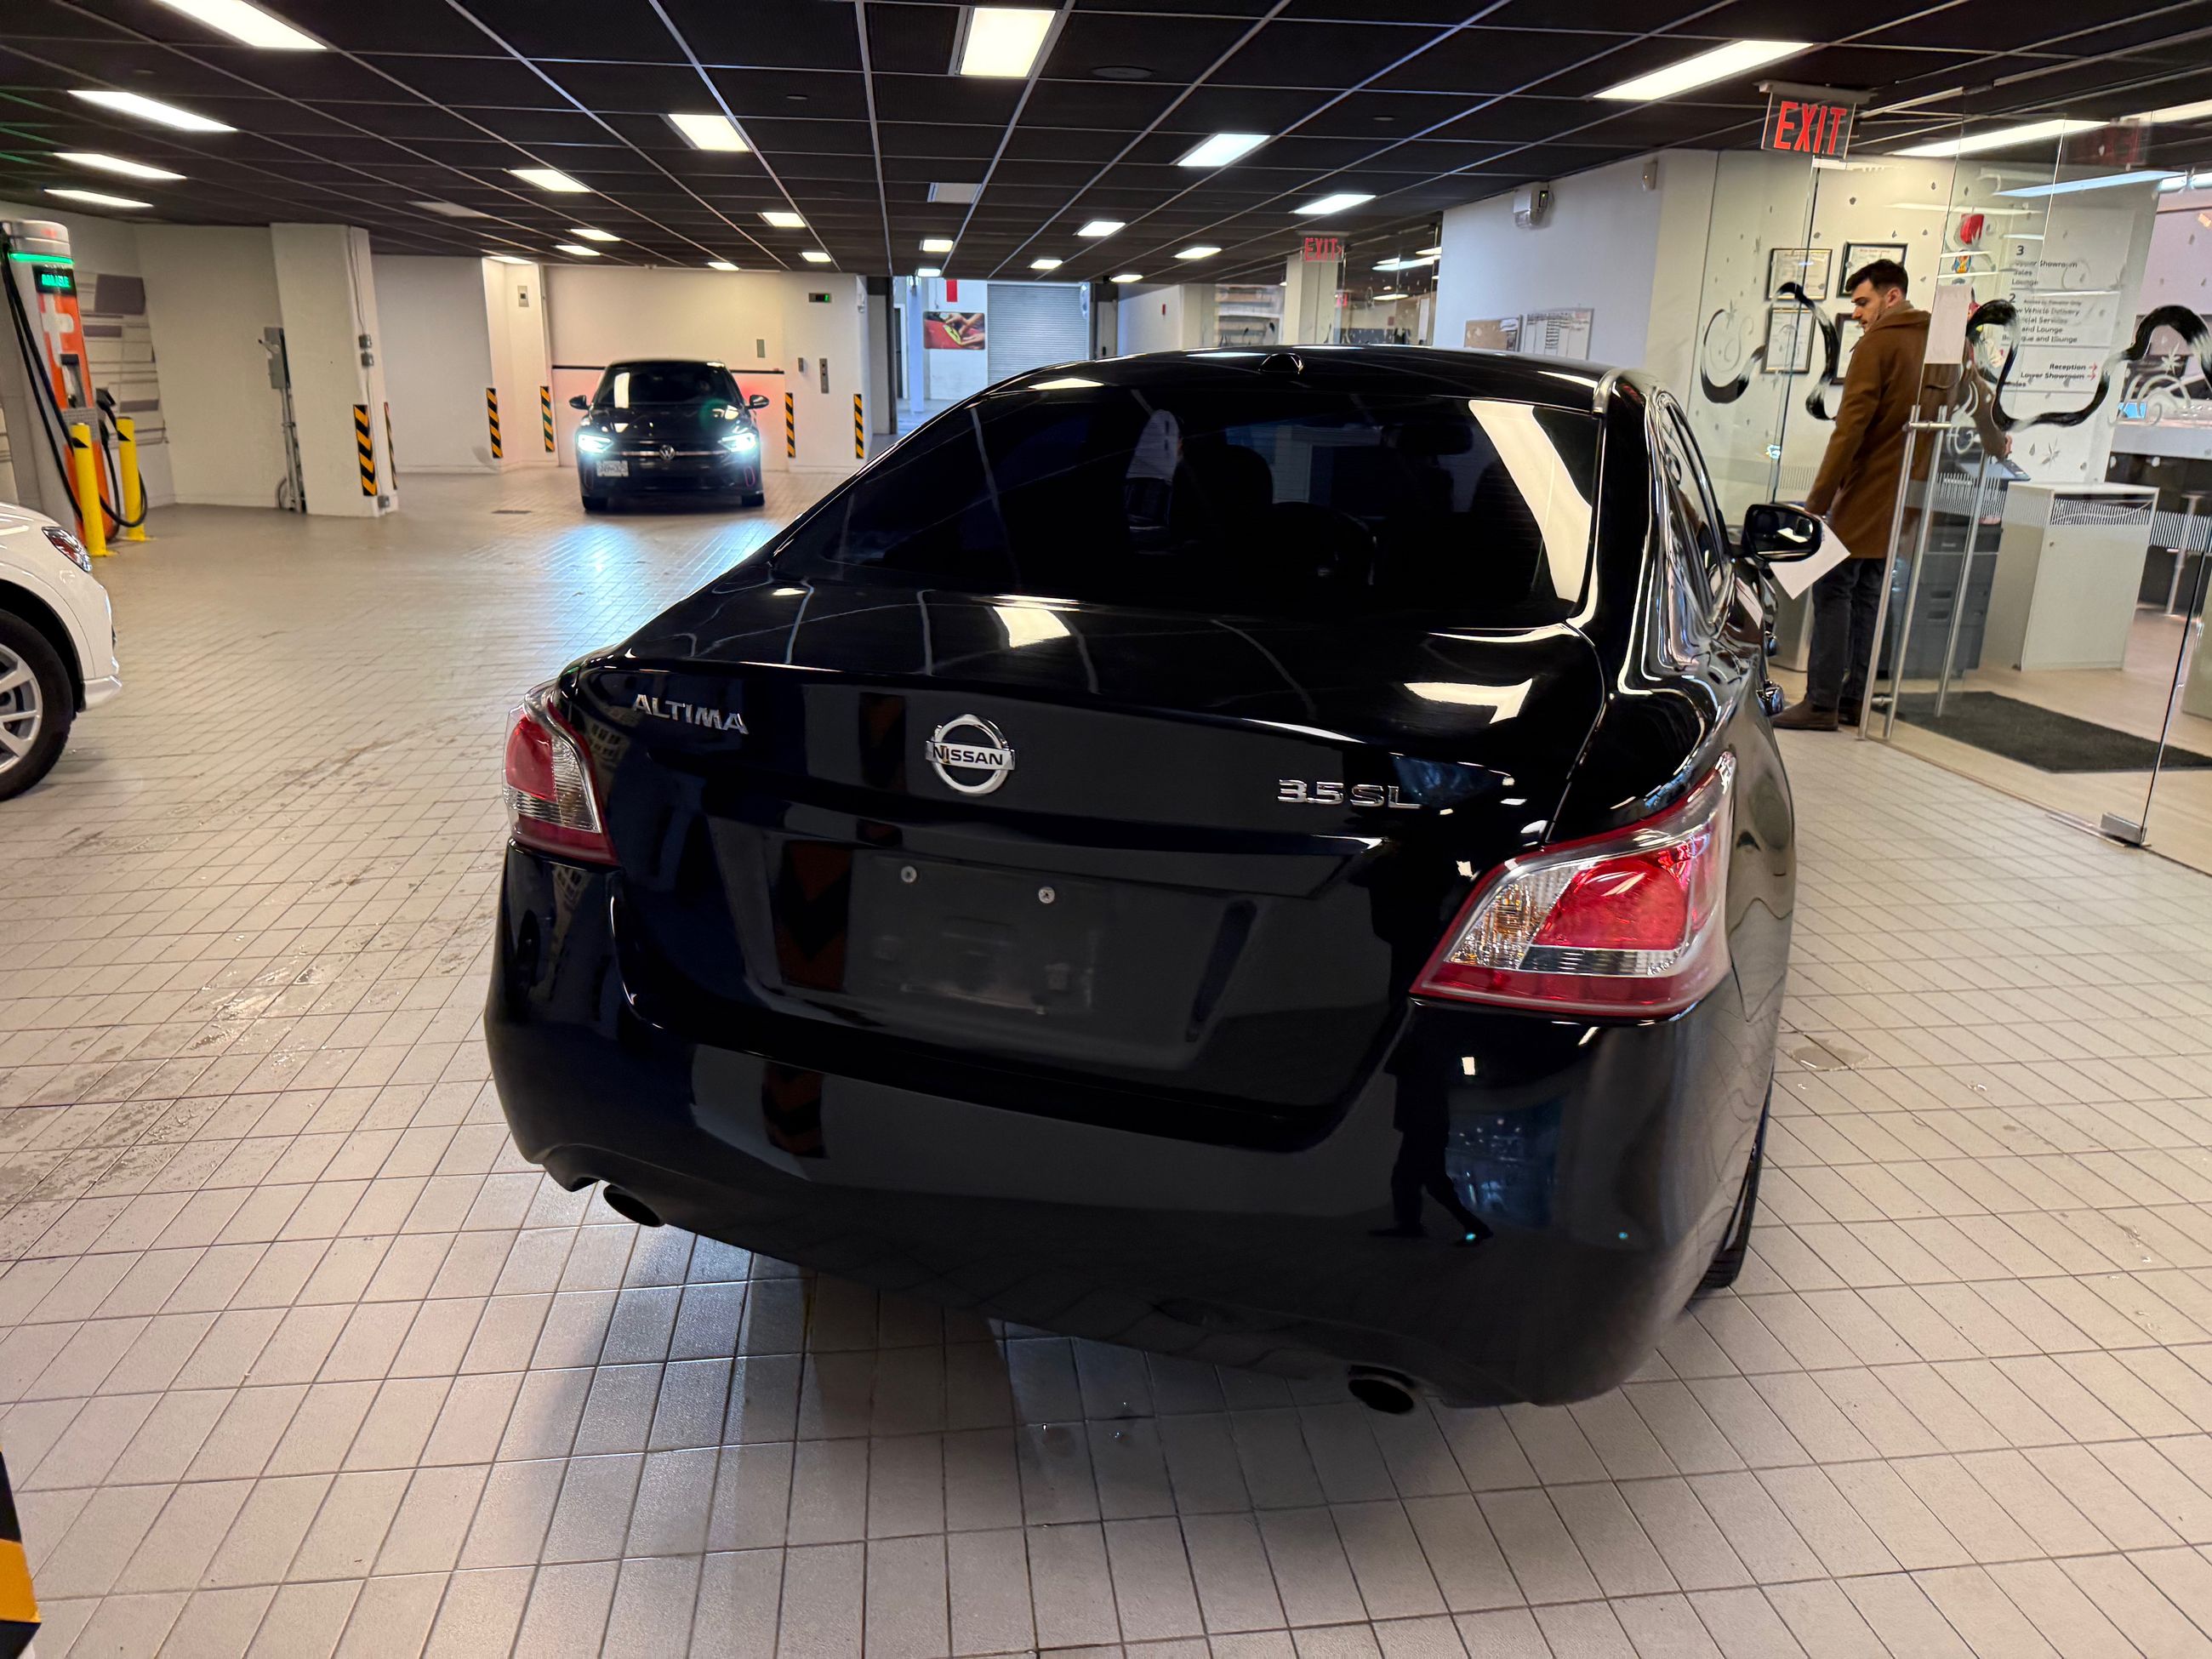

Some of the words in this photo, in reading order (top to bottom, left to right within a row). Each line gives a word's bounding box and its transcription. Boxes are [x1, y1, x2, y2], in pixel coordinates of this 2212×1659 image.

[1774, 100, 1847, 155] EXIT
[1304, 237, 1338, 261] EXIT
[2015, 245, 2024, 255] 3
[2010, 294, 2016, 303] 2
[633, 693, 749, 734] ALTIMA
[932, 745, 1005, 767] NISSAN
[1349, 784, 1422, 809] SL
